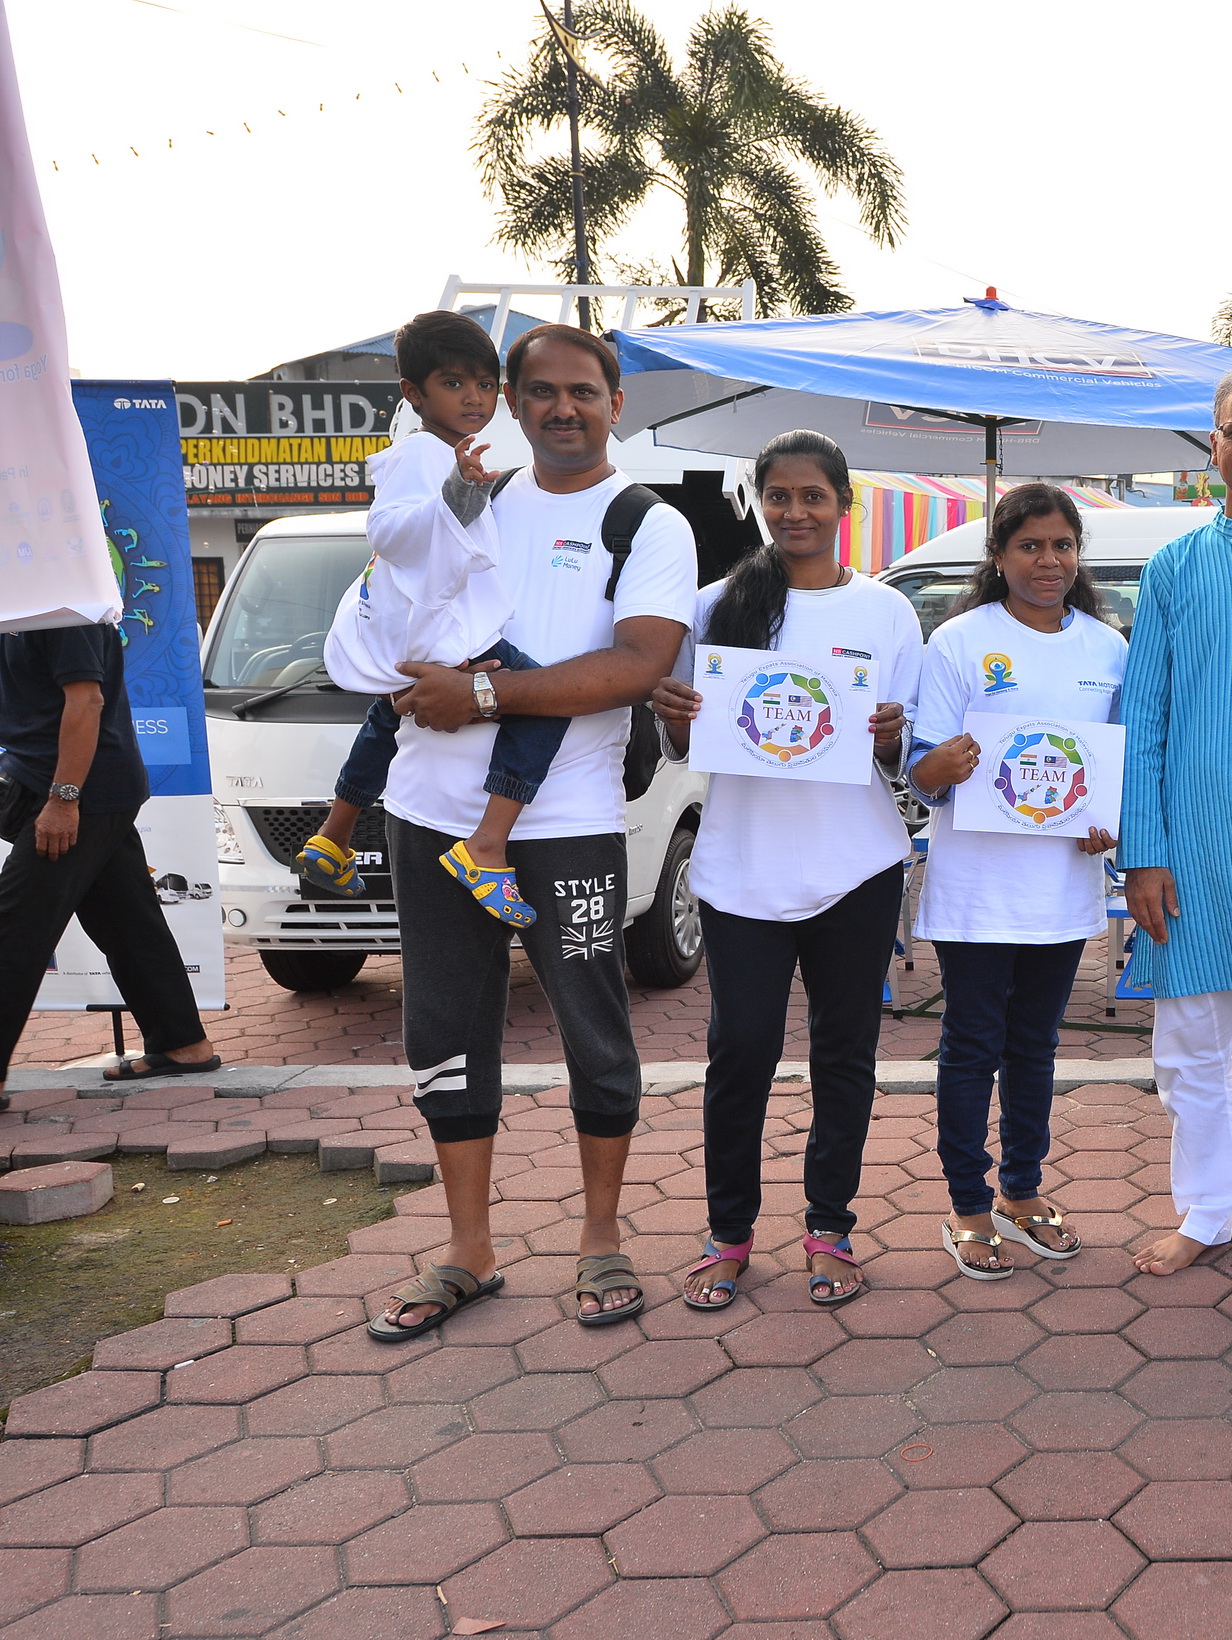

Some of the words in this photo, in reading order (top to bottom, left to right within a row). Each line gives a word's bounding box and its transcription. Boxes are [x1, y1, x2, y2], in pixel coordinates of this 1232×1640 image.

[1012, 369, 1098, 384] Commercial
[1102, 379, 1162, 388] Vehicles
[132, 399, 167, 409] TATA
[271, 394, 376, 434] BHD
[180, 437, 327, 464] PERKHIDMATAN
[253, 463, 361, 488] SERVICES
[236, 492, 314, 503] INTERCHANGE
[318, 492, 342, 502] SDN
[346, 491, 369, 502] BHD
[741, 670, 758, 684] Telugu
[758, 662, 778, 672] Expats
[780, 661, 813, 673] Association
[821, 675, 838, 697] Malaysia
[1098, 682, 1119, 690] MOTOR
[763, 706, 812, 722] TEAM
[132, 719, 169, 735] ESS
[999, 731, 1015, 745] Telugu
[1016, 722, 1035, 732] Expats
[1036, 721, 1069, 732] Association
[1075, 735, 1092, 758] Malaysia
[226, 775, 264, 788] TATA
[1019, 767, 1066, 783] TEAM
[554, 873, 615, 897] STYLE
[570, 895, 604, 924] 28
